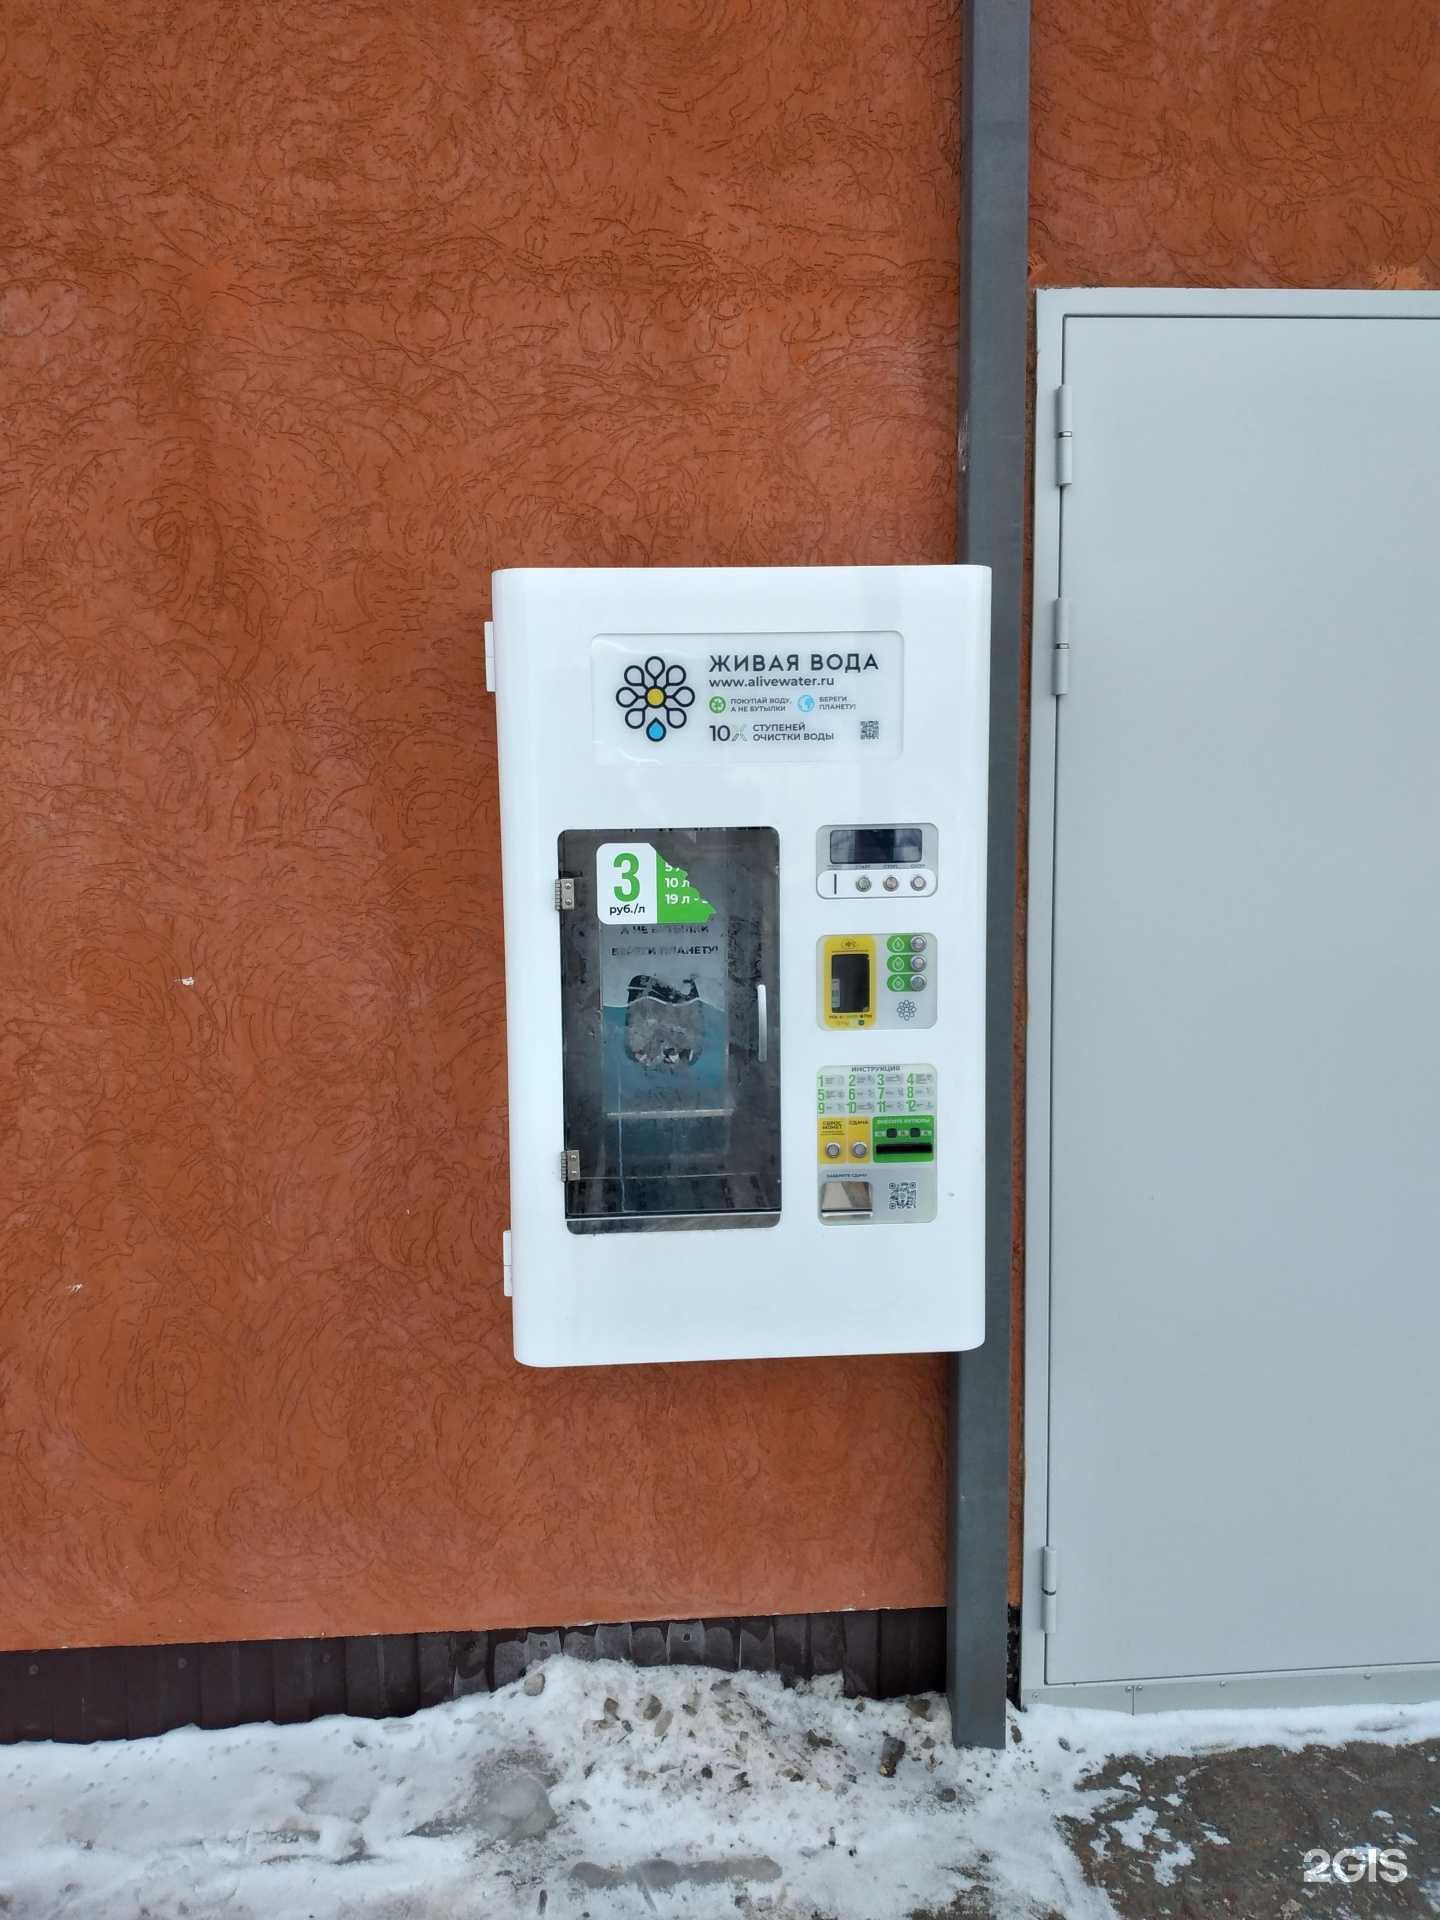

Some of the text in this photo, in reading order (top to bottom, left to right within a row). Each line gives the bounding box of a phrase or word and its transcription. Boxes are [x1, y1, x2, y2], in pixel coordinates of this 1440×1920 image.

[709, 653, 879, 673] ЖИВАЯ ВОДА
[709, 675, 835, 688] www.alivewater.ru
[730, 697, 768, 705] ПОКУПАЙ
[752, 722, 806, 732] СТУПЕНЕЙ
[752, 733, 835, 742] ОЧИСТКИ ВОДЫ
[613, 852, 641, 902] 3
[664, 877, 679, 888] 10
[664, 893, 679, 904] 19
[681, 895, 690, 904] л
[609, 904, 646, 916] руб./л
[818, 1075, 824, 1088] 1
[848, 1074, 857, 1087] 2
[877, 1073, 885, 1086] 3
[906, 1073, 915, 1085] 4
[817, 1088, 825, 1101] 5
[848, 1088, 856, 1101] 6
[877, 1087, 886, 1099] 7
[907, 1086, 914, 1099] 8
[817, 1102, 825, 1114] 9
[847, 1102, 857, 1114] 10
[877, 1101, 886, 1112] 11
[906, 1100, 917, 1111] 12
